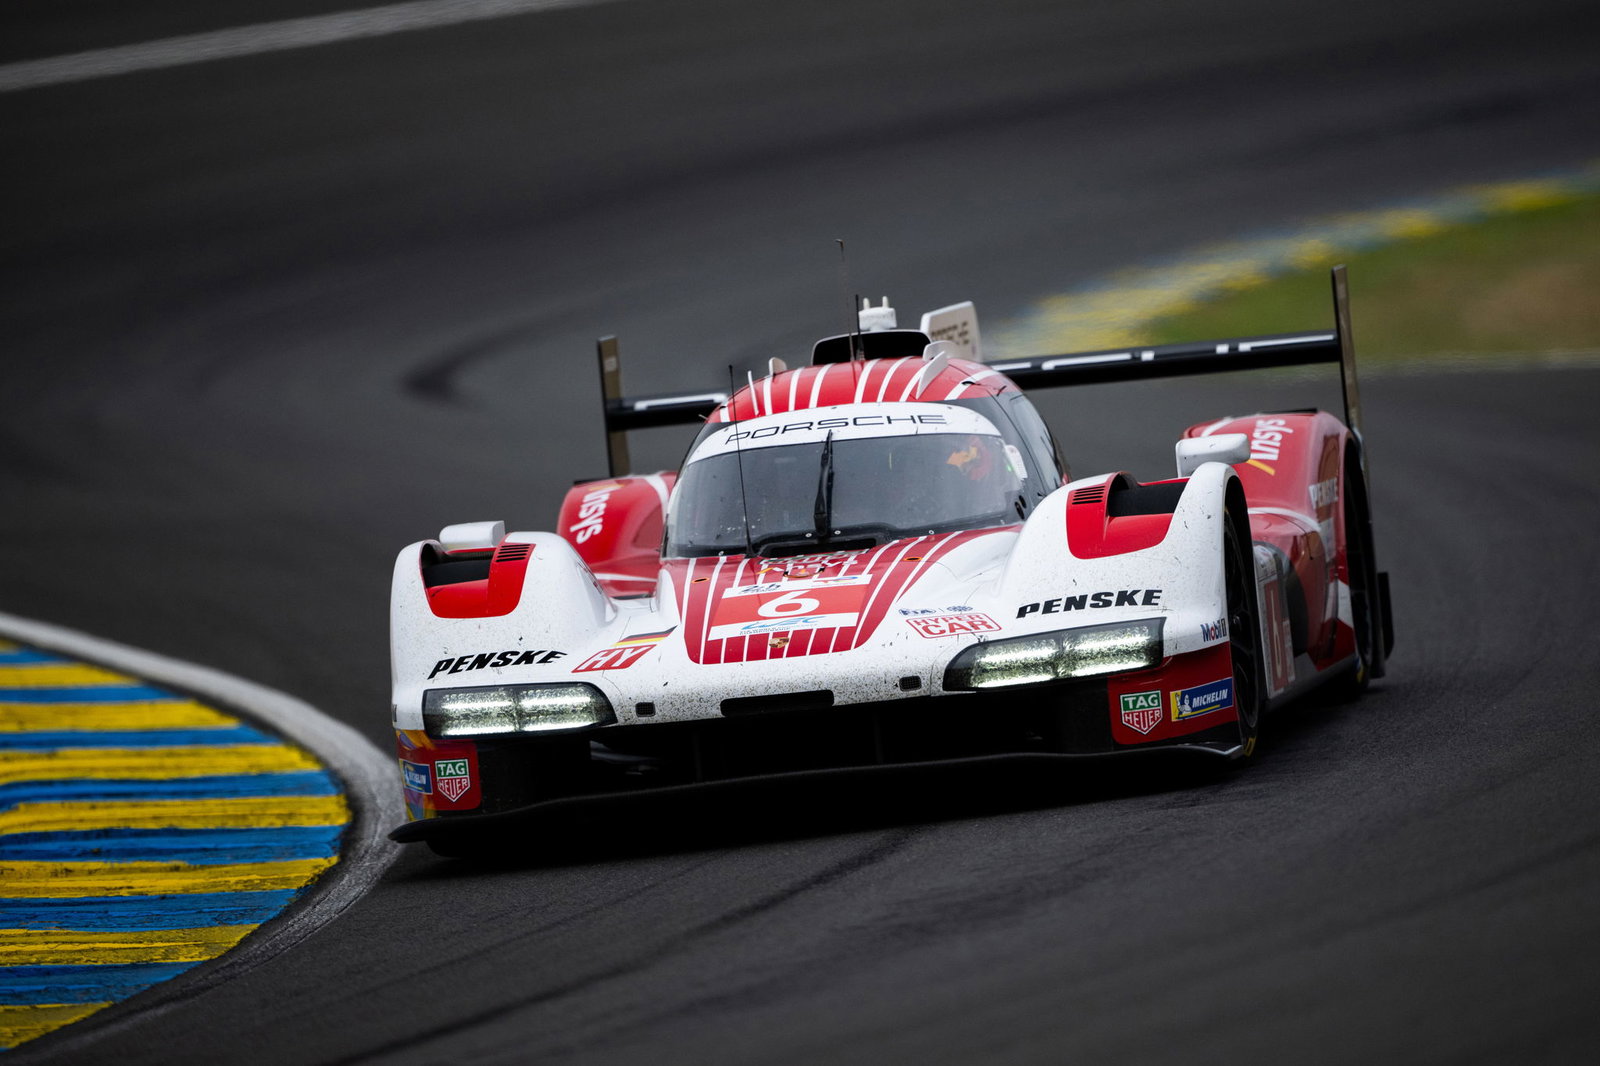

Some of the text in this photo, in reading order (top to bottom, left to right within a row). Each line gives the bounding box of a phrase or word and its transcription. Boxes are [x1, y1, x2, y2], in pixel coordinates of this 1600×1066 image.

[725, 415, 947, 444] PORSCHE
[1248, 419, 1293, 475] Ansys
[757, 590, 820, 617] 6
[1016, 590, 1163, 619] PENSKE
[913, 615, 983, 625] HYPER
[922, 620, 994, 635] CAR
[1200, 620, 1222, 642] Mobil
[427, 650, 568, 680] PENSKE
[576, 647, 651, 670] HY
[1124, 694, 1158, 709] TAG
[1192, 689, 1228, 708] MICHELIN
[1124, 709, 1161, 731] HEUER
[438, 762, 466, 776] TAG
[438, 778, 468, 799] HEUER
